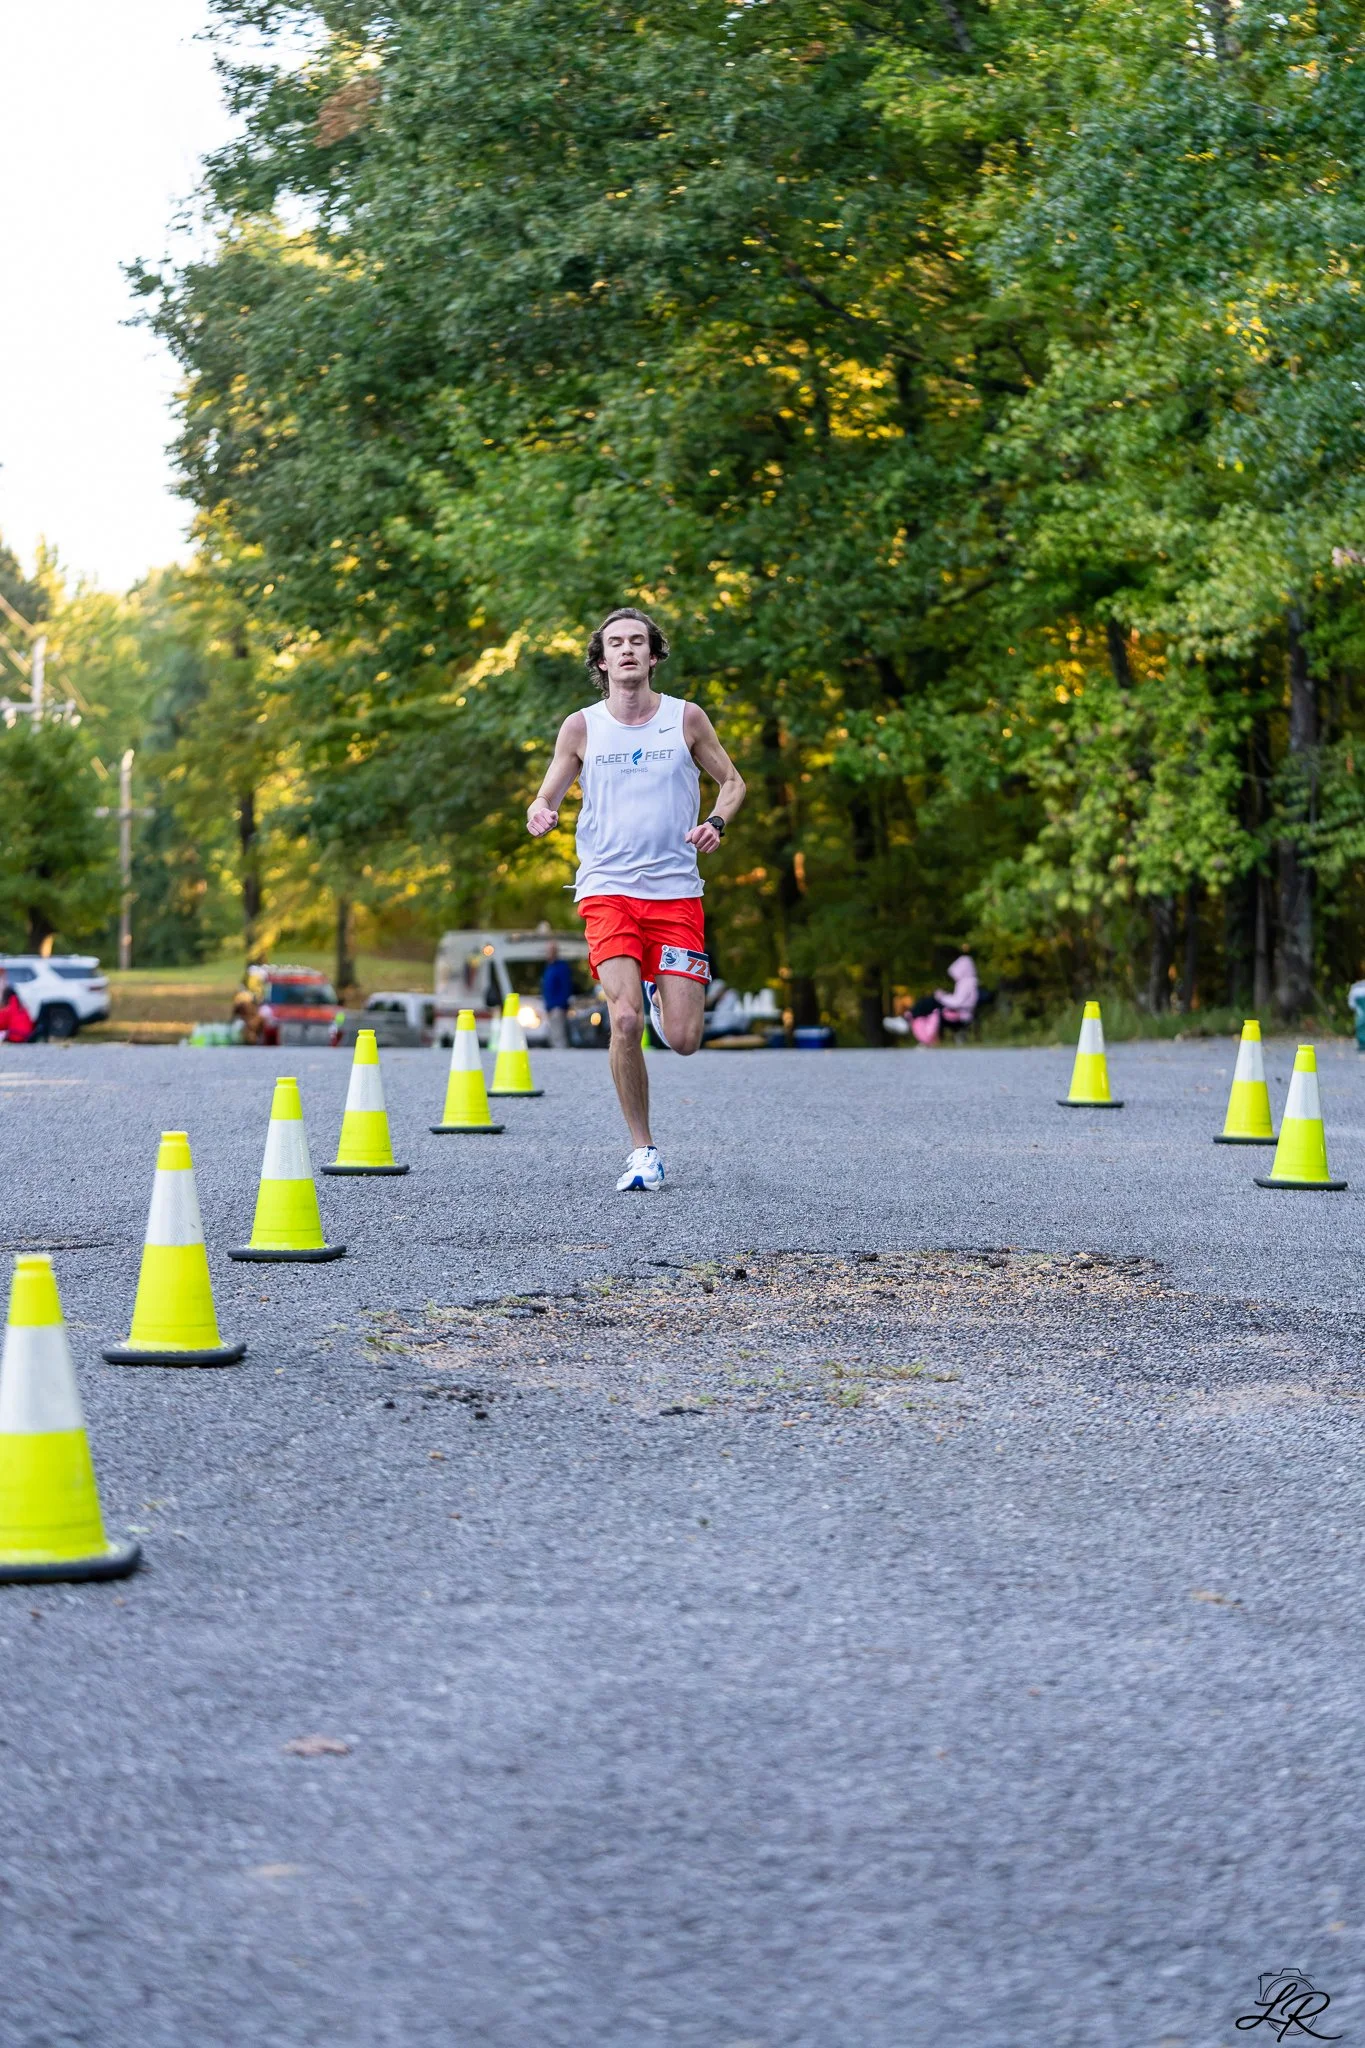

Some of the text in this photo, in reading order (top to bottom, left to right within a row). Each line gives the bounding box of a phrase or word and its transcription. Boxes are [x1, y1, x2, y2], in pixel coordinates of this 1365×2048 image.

[595, 749, 674, 765] FLEET FEET
[620, 767, 649, 775] MEMPHIS
[687, 957, 710, 978] 72
